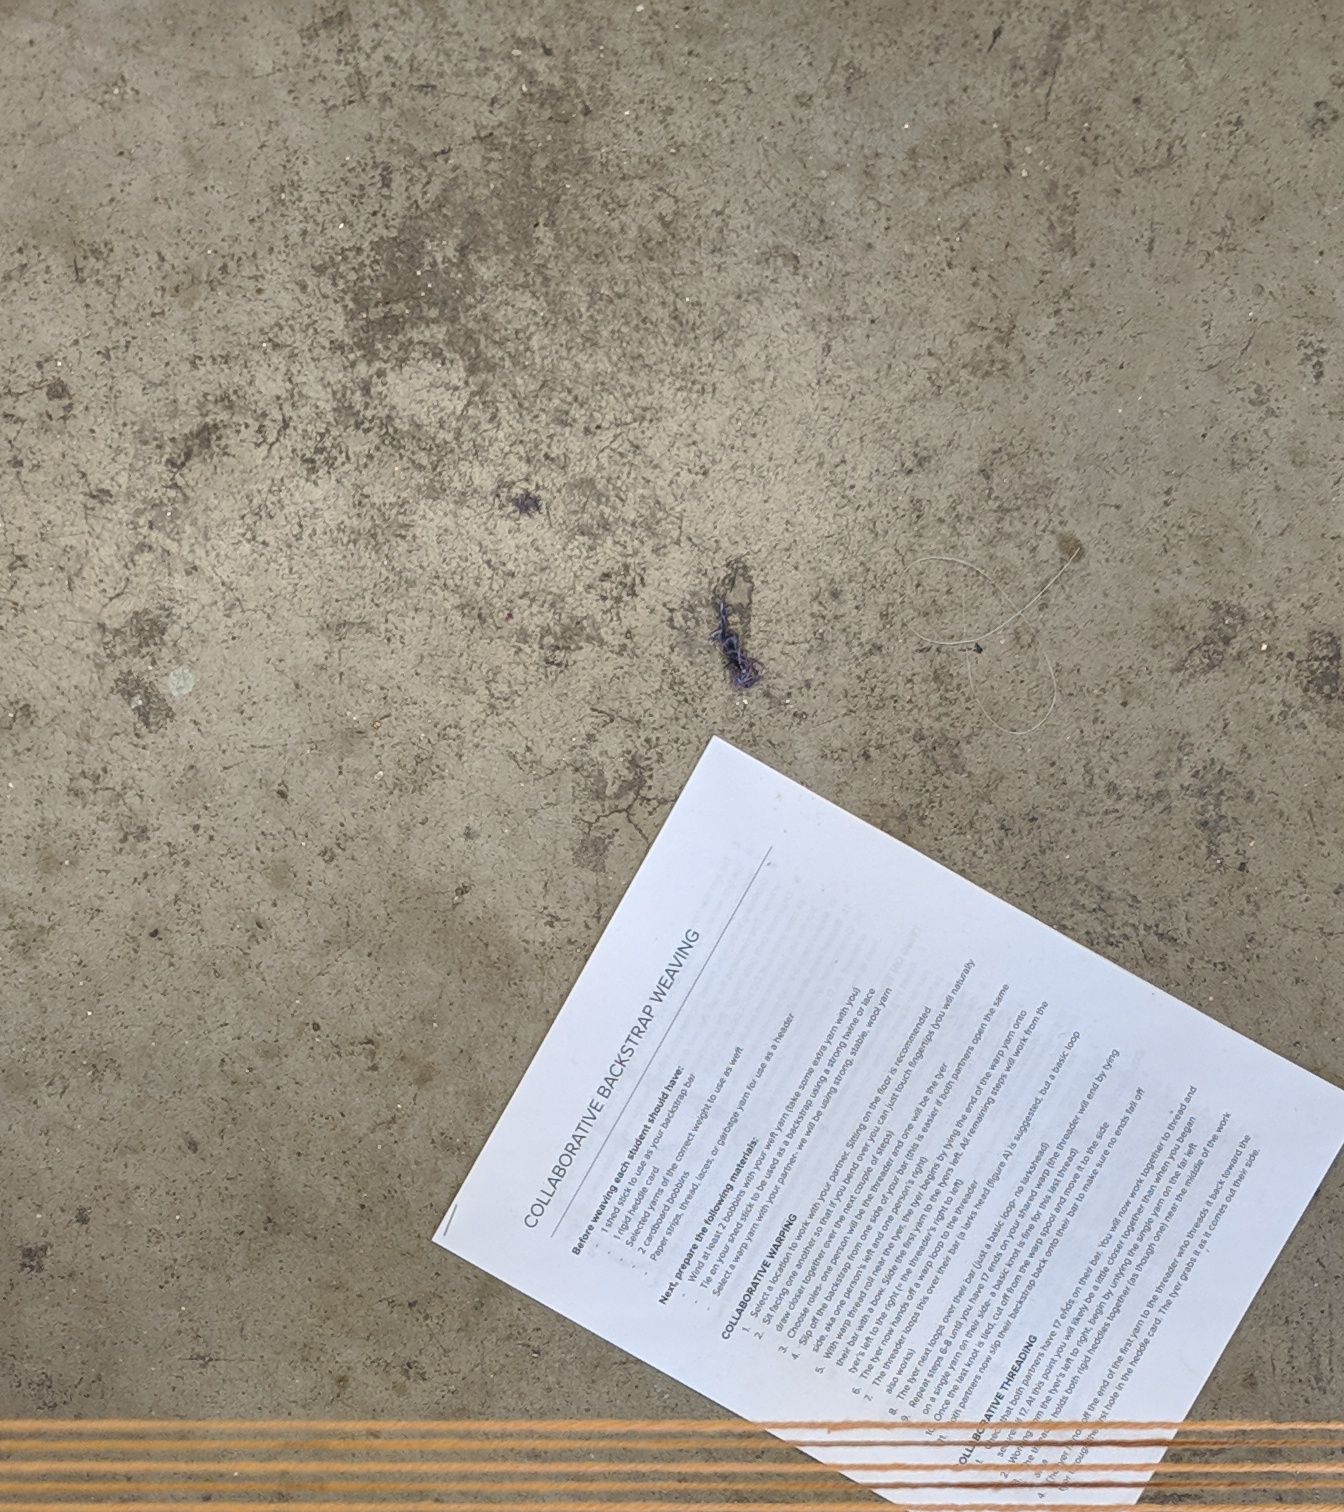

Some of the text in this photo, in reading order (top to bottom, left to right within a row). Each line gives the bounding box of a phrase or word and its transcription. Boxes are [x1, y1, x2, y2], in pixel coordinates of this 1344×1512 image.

[893, 1005, 932, 1067] recommended
[523, 928, 700, 1228] COLLABORATIVE BACKSTRAP WEAVING
[876, 1074, 893, 1095] floor
[887, 1066, 898, 1076] is
[862, 1110, 872, 1123] on
[867, 1095, 882, 1111] the
[571, 1065, 684, 1256] Before weaving each student should have:
[604, 1205, 621, 1228] shed
[616, 1185, 632, 1208] stick
[627, 1176, 638, 1187] to
[633, 1159, 647, 1177] use
[643, 1147, 654, 1160] as
[649, 1128, 664, 1150] your
[658, 1087, 688, 1130] backstrap
[682, 1072, 696, 1089] bar
[624, 1046, 744, 1248] Selected yarns of the correct weight to use as weft
[648, 1012, 795, 1262] Paper strips, thread, laces, or garbage yarn for use as a header
[686, 986, 862, 1282] Wind at least 2 bobbins with your weft yarn (take some extra yarn with you)
[698, 987, 876, 1289] Tie on your shed stick to be used as a backstrap using a strong twine or lace
[711, 987, 893, 1297] Select a warp yarn with your partner- we will be using strong, stable, wool yarn
[844, 1122, 868, 1150] Sitting
[816, 1180, 832, 1204] your
[828, 1150, 851, 1184] partner.
[616, 1213, 633, 1236] rigid
[626, 1186, 649, 1217] heddle
[645, 1165, 660, 1186] card
[636, 1169, 690, 1255] 2 cardboard bobbins
[658, 1136, 759, 1305] Next, prepare the following materials:
[793, 1219, 811, 1241] work
[806, 1201, 822, 1220] with
[775, 1129, 896, 1332] draw closer together over the next couple of steps)
[787, 1241, 798, 1252] to
[720, 1212, 798, 1340] COLLABORATIVE WARPING
[765, 1284, 774, 1292] a
[768, 1251, 793, 1285] location
[749, 1291, 770, 1319] Select
[998, 1334, 1038, 1391] THREADING
